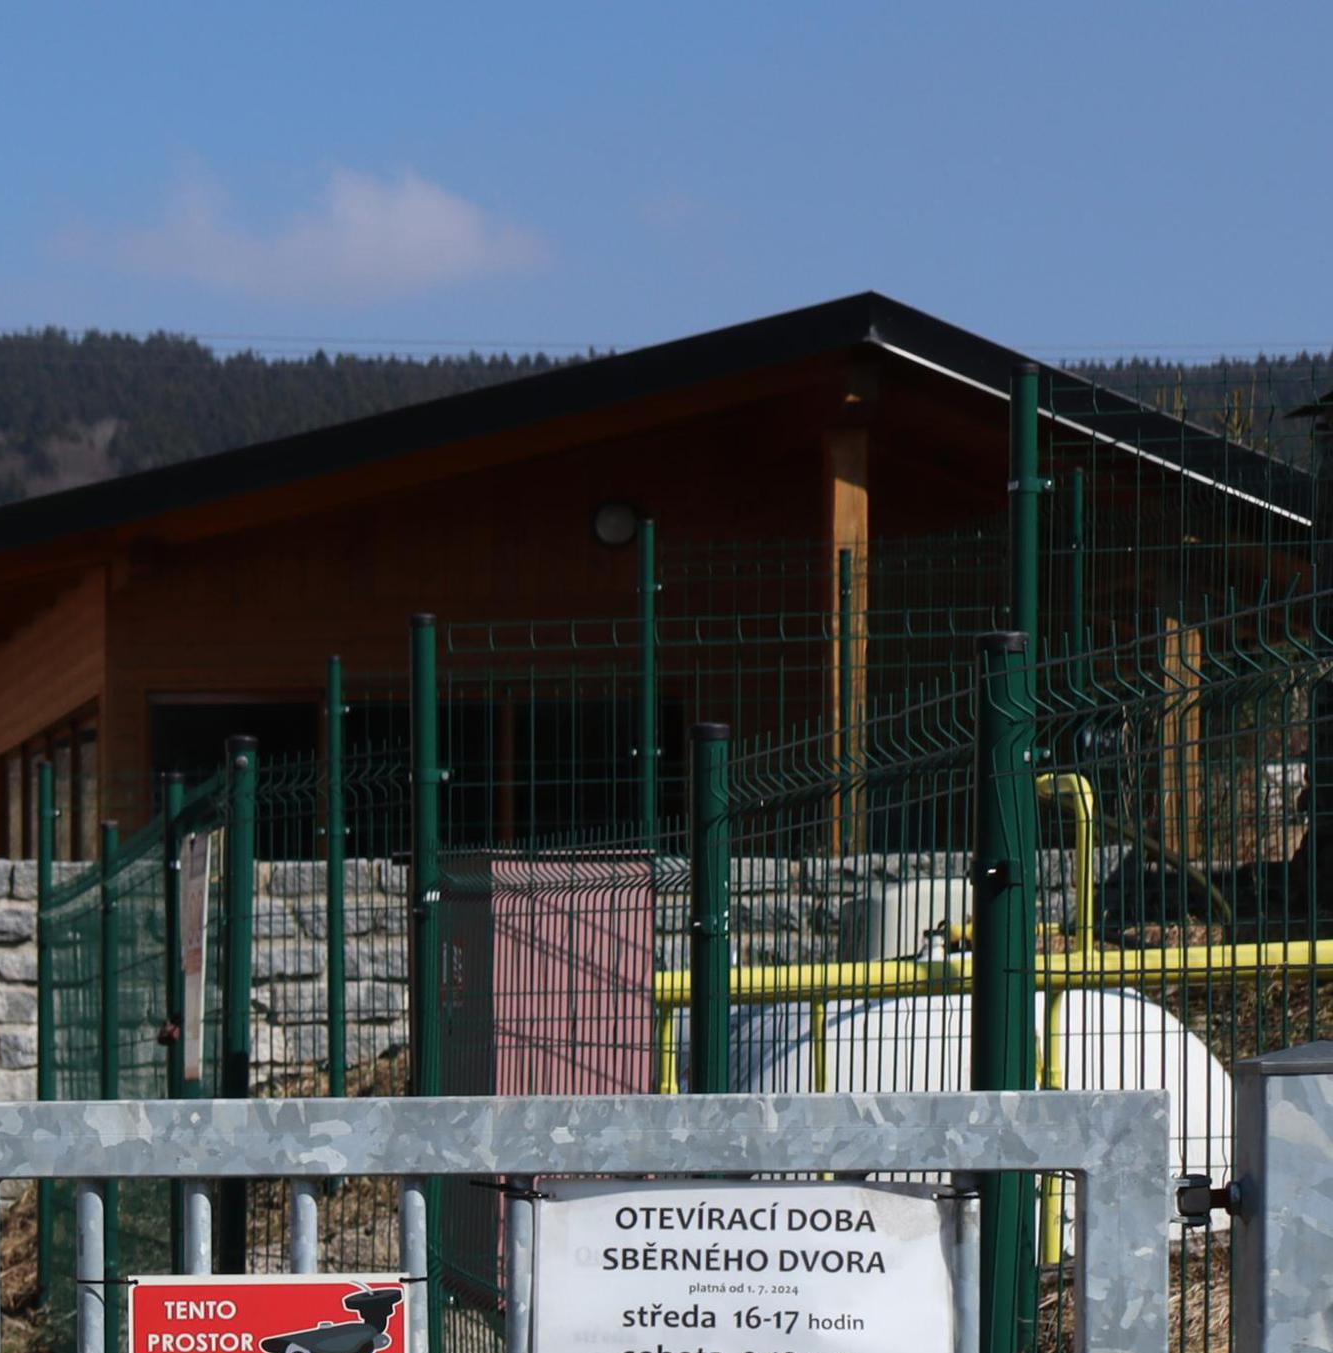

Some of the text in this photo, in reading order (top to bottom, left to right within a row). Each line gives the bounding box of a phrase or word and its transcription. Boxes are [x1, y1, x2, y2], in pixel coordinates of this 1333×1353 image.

[615, 1201, 876, 1233] OTEVÍRACÍ DOBA
[602, 1241, 769, 1273] SBĚRNÉHO
[778, 1249, 886, 1274] DVORA
[688, 1282, 727, 1296] platná
[728, 1282, 745, 1294] od
[770, 1284, 799, 1296] 2024
[163, 1300, 237, 1320] TENTO
[622, 1303, 865, 1335] středa 16-17 hodin
[147, 1332, 254, 1353] PROSTOR
